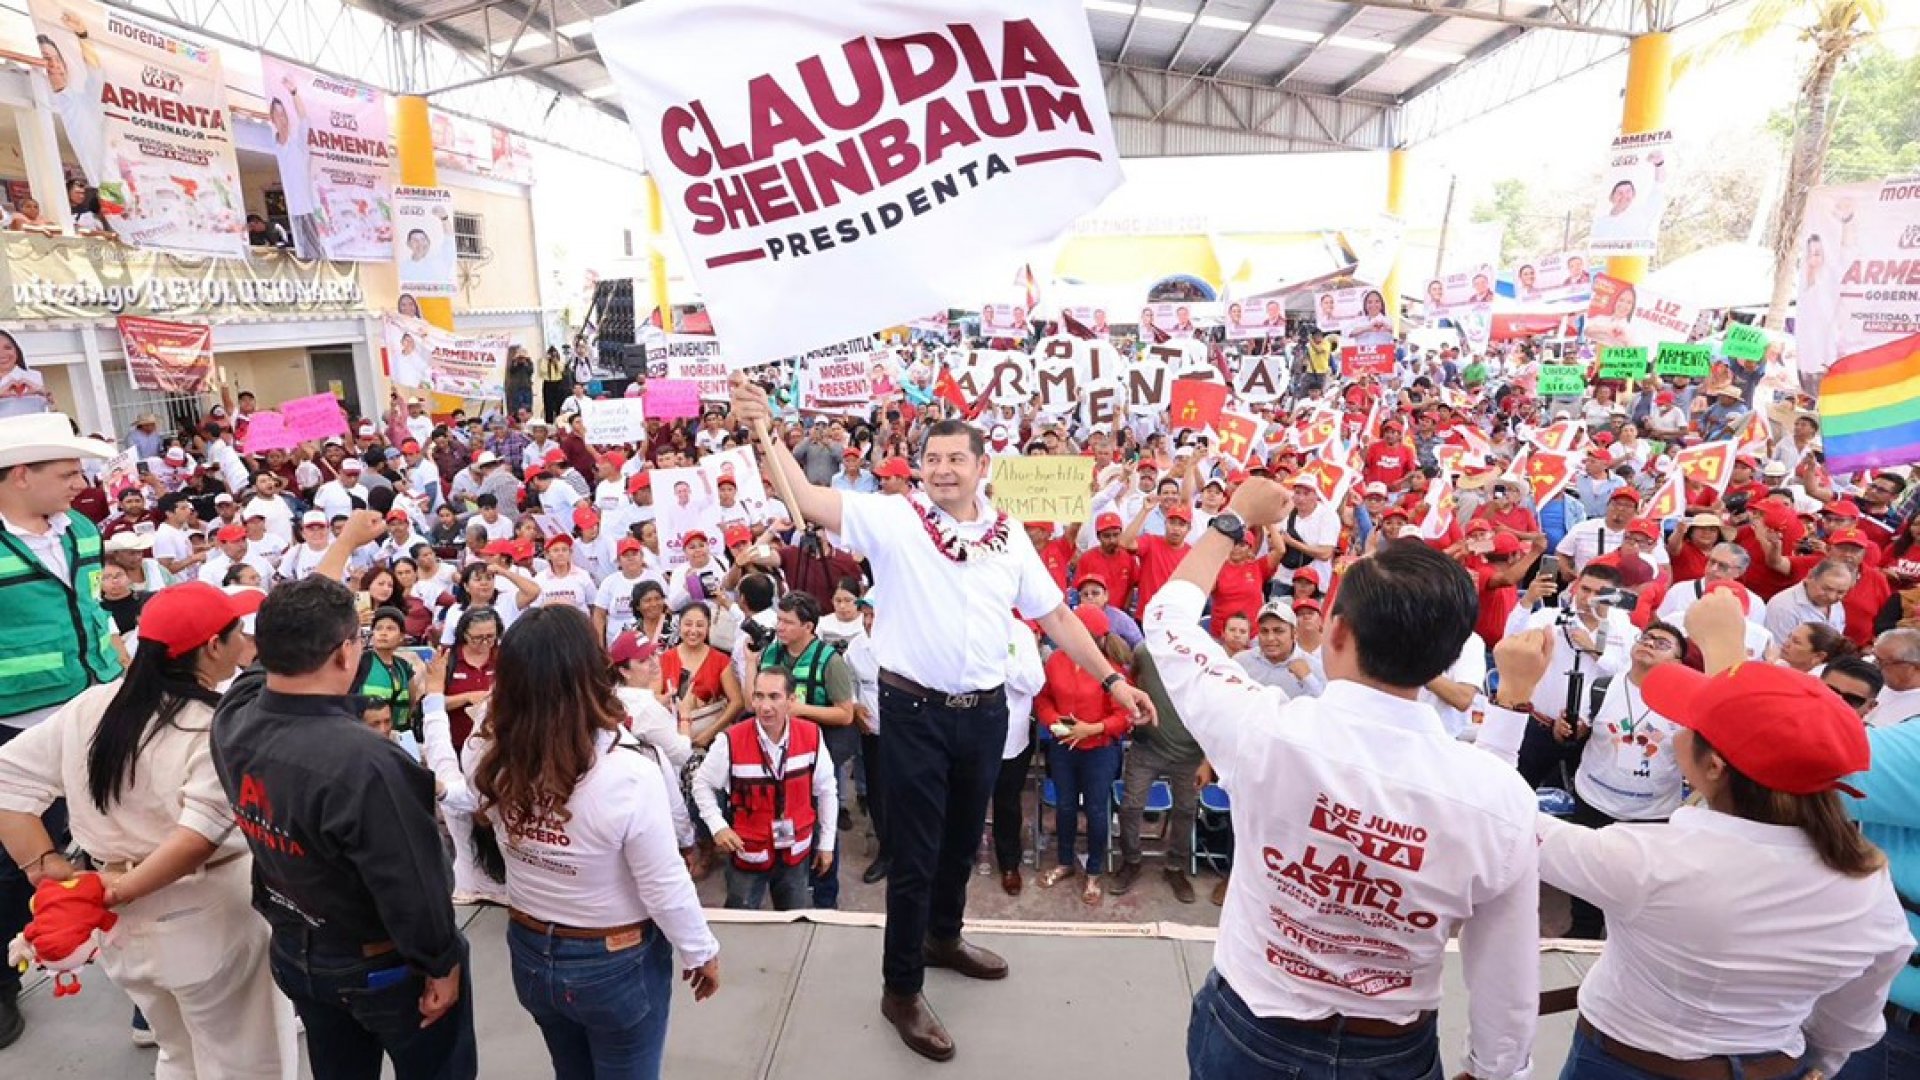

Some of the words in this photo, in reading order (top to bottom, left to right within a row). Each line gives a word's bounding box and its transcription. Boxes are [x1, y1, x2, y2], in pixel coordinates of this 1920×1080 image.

[107, 18, 166, 50] morena
[101, 81, 226, 132] ARMENTA
[661, 17, 1080, 178] CLAUDIA
[307, 127, 389, 159] ARMENTA
[1611, 131, 1672, 147] ARMENTA
[683, 85, 1094, 235] SHEINBAUM
[395, 187, 450, 198] ARMENTA
[766, 152, 1011, 261] PRESIDENTA
[1655, 299, 1681, 317] LIZ
[1864, 290, 1920, 301] GOBERN
[432, 346, 497, 363] ARMENTA
[680, 363, 727, 378] MORENA
[1181, 406, 1199, 421] PT
[1317, 793, 1329, 806] 2
[1333, 803, 1361, 823] DE
[1364, 815, 1427, 843] JUNIO
[1322, 812, 1412, 867] VOTA
[1262, 846, 1438, 928] CASTILLO
[1302, 845, 1402, 899] LALO
